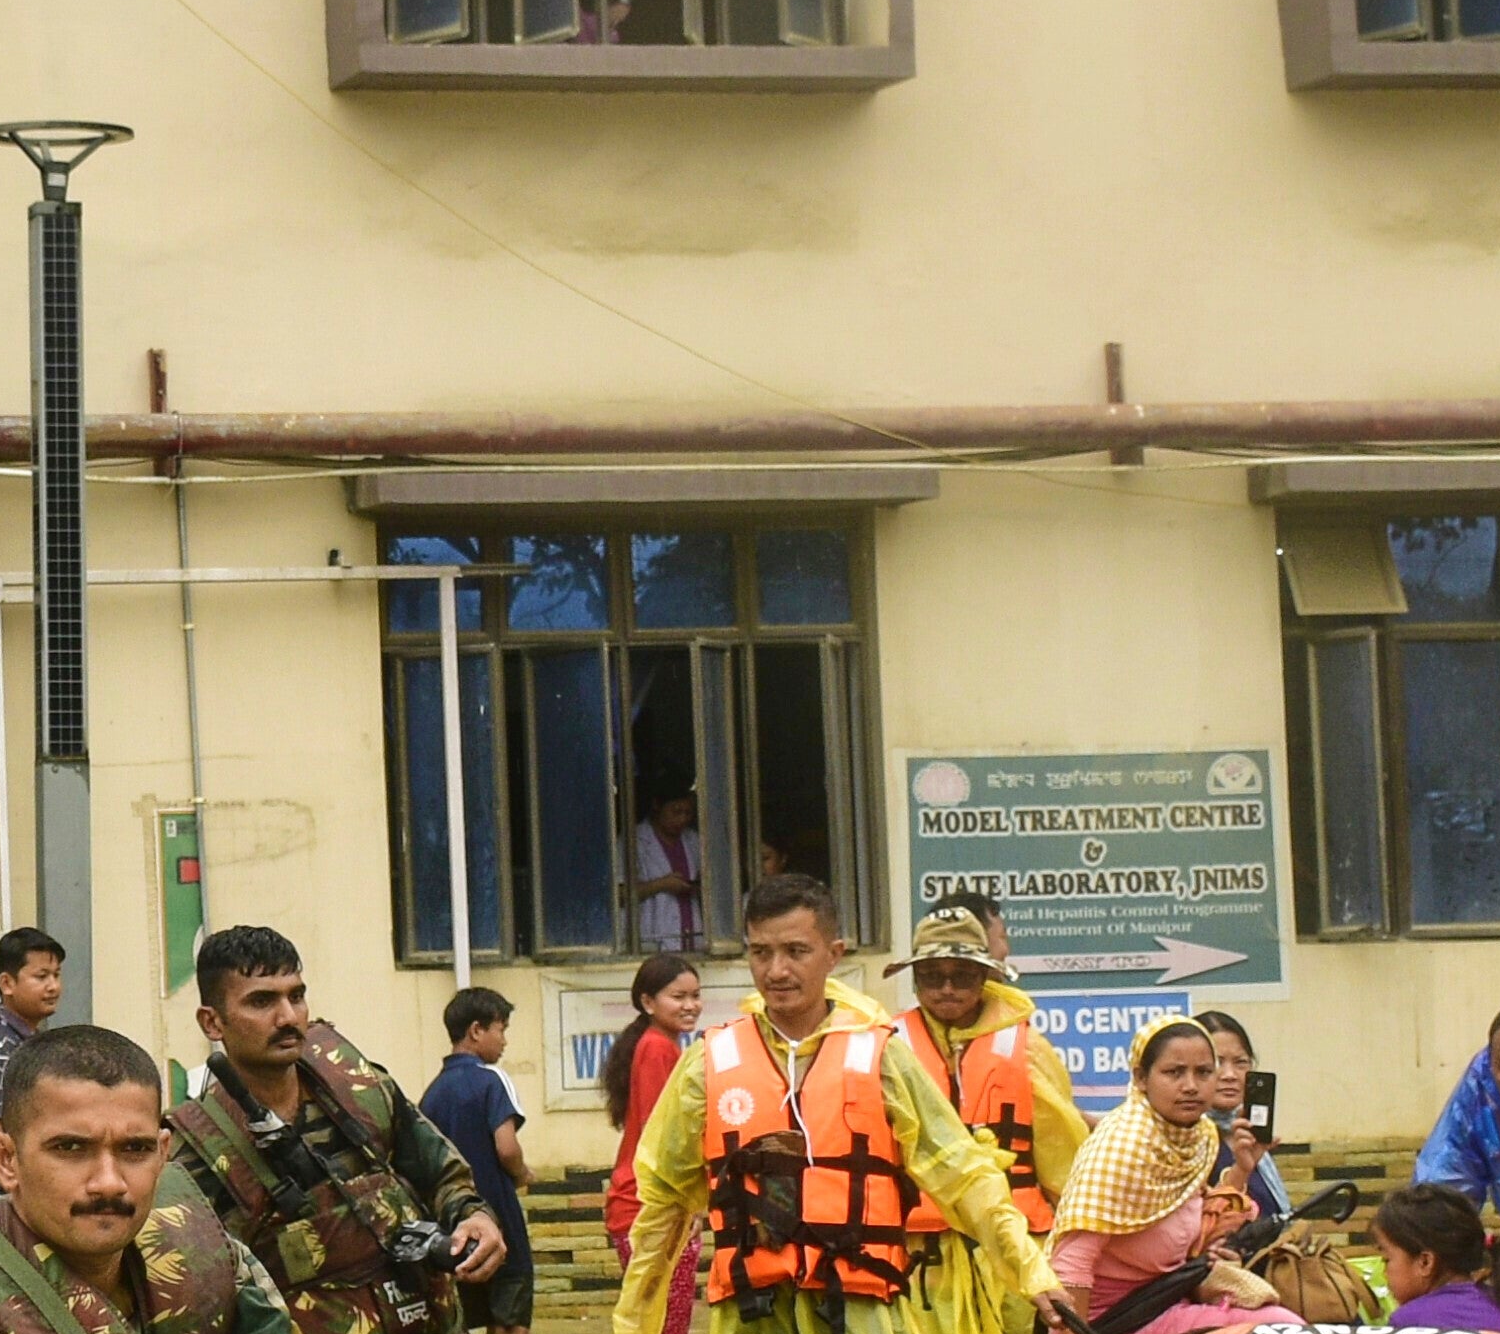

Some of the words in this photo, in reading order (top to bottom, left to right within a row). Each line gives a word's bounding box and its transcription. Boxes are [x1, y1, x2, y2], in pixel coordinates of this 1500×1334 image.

[921, 809, 1010, 834] MODEL
[1013, 806, 1163, 832] TREATMENT
[1169, 803, 1262, 828] CENTRE
[1084, 842, 1104, 863] &
[923, 875, 1001, 898] STATE
[1009, 870, 1185, 897] LABORATORY,
[1191, 867, 1264, 896] JNIMS
[1037, 905, 1106, 922] Hepatitis
[1111, 904, 1168, 917] Control
[1173, 903, 1263, 918] Programme
[1007, 923, 1101, 938] Government
[1107, 921, 1125, 934] Of
[1130, 920, 1193, 937] Manipur
